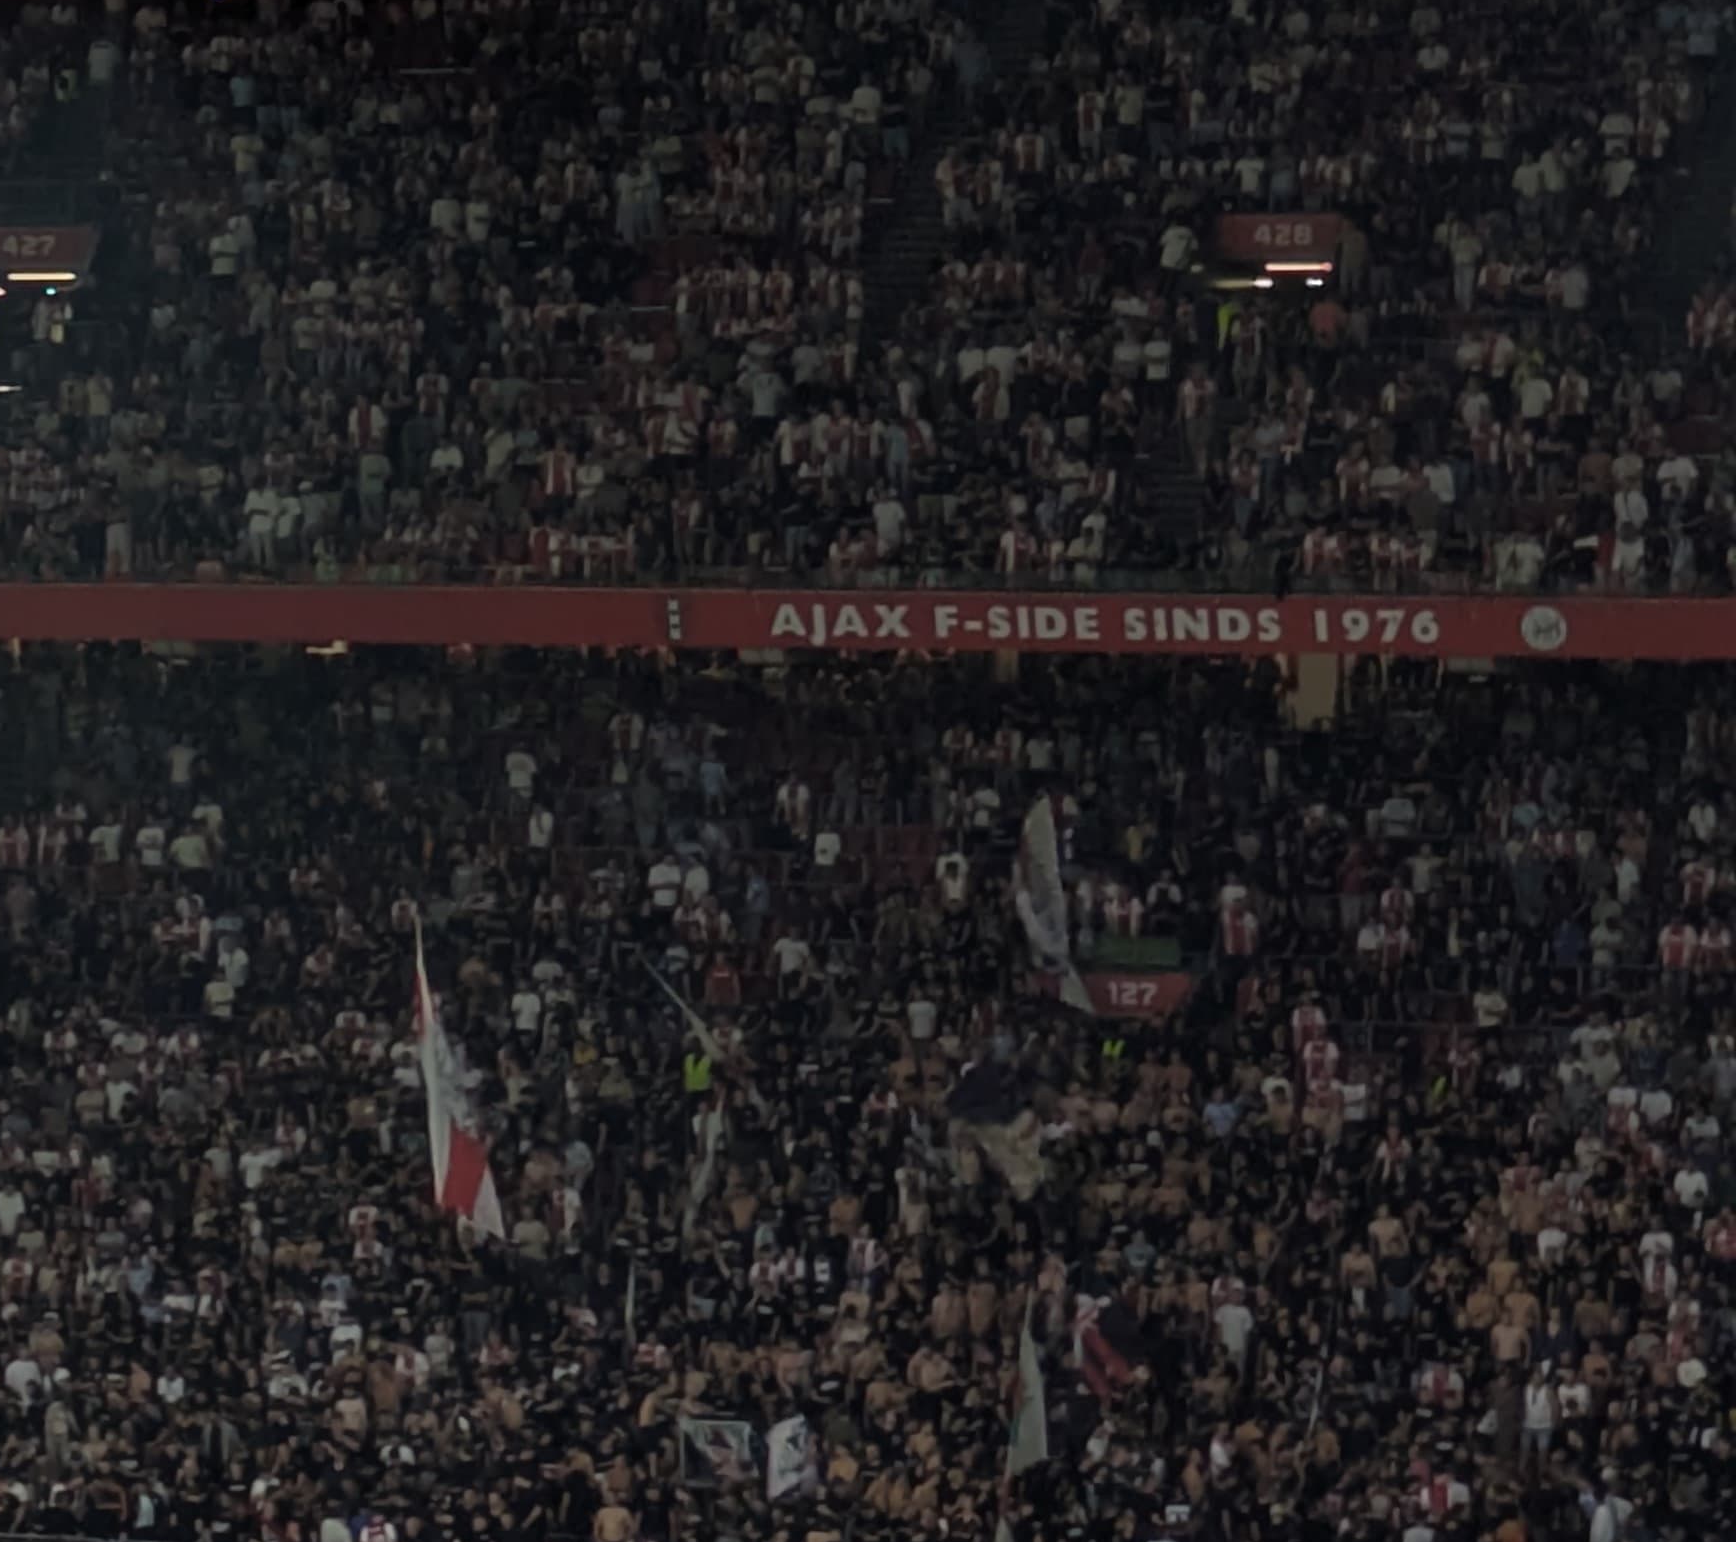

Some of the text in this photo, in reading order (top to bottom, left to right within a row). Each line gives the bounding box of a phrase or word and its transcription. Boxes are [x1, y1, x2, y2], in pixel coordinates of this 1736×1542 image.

[2, 234, 57, 258] 427
[1254, 224, 1314, 247] 428
[769, 604, 1440, 647] AJAX F-SIDE SINDS 1976
[1106, 980, 1159, 1006] 127
